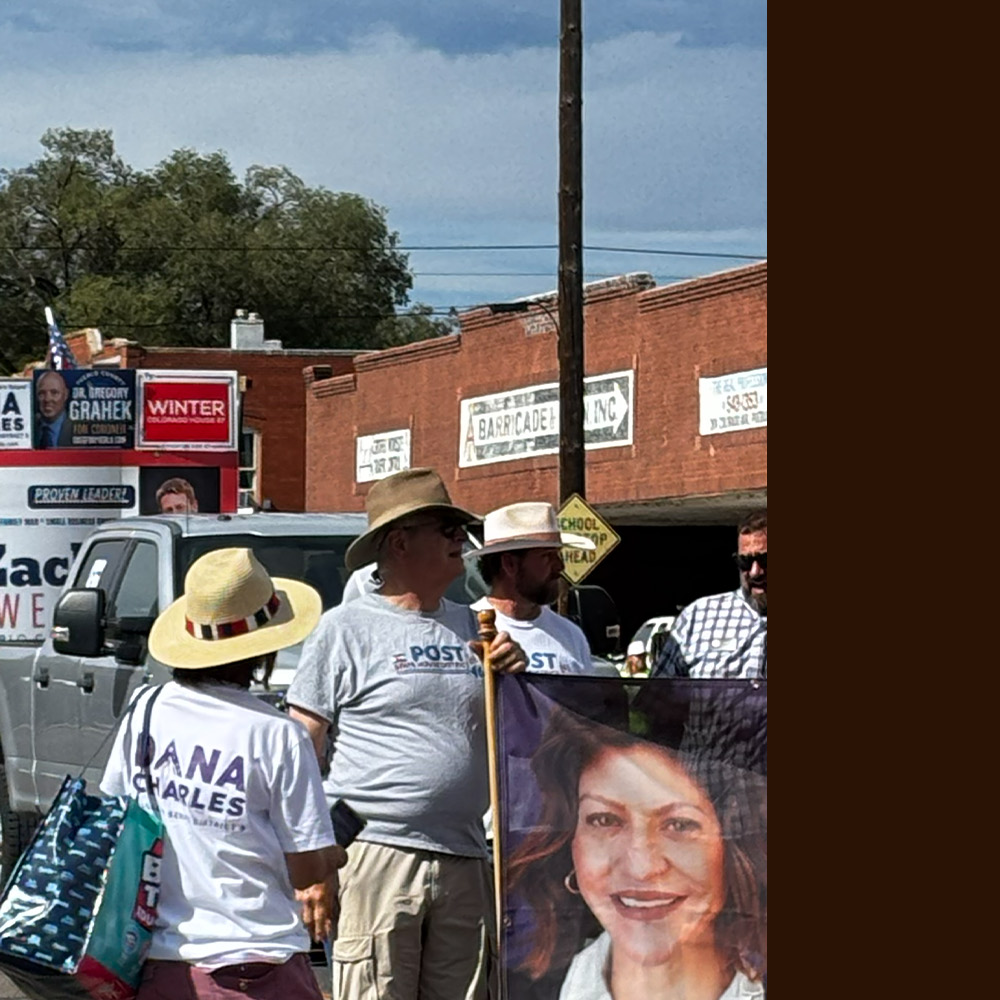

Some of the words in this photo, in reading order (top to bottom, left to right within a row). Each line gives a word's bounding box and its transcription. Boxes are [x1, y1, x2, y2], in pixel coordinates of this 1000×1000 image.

[88, 386, 129, 399] GREGORY
[69, 400, 132, 421] GRAHEK
[147, 400, 226, 416] WINTER
[478, 409, 548, 441] BARRICADE
[34, 487, 78, 501] PROVEN
[82, 486, 127, 501] LEADER!
[557, 517, 600, 531] CHOOL
[562, 550, 596, 563] HEAD
[409, 646, 464, 662] POST
